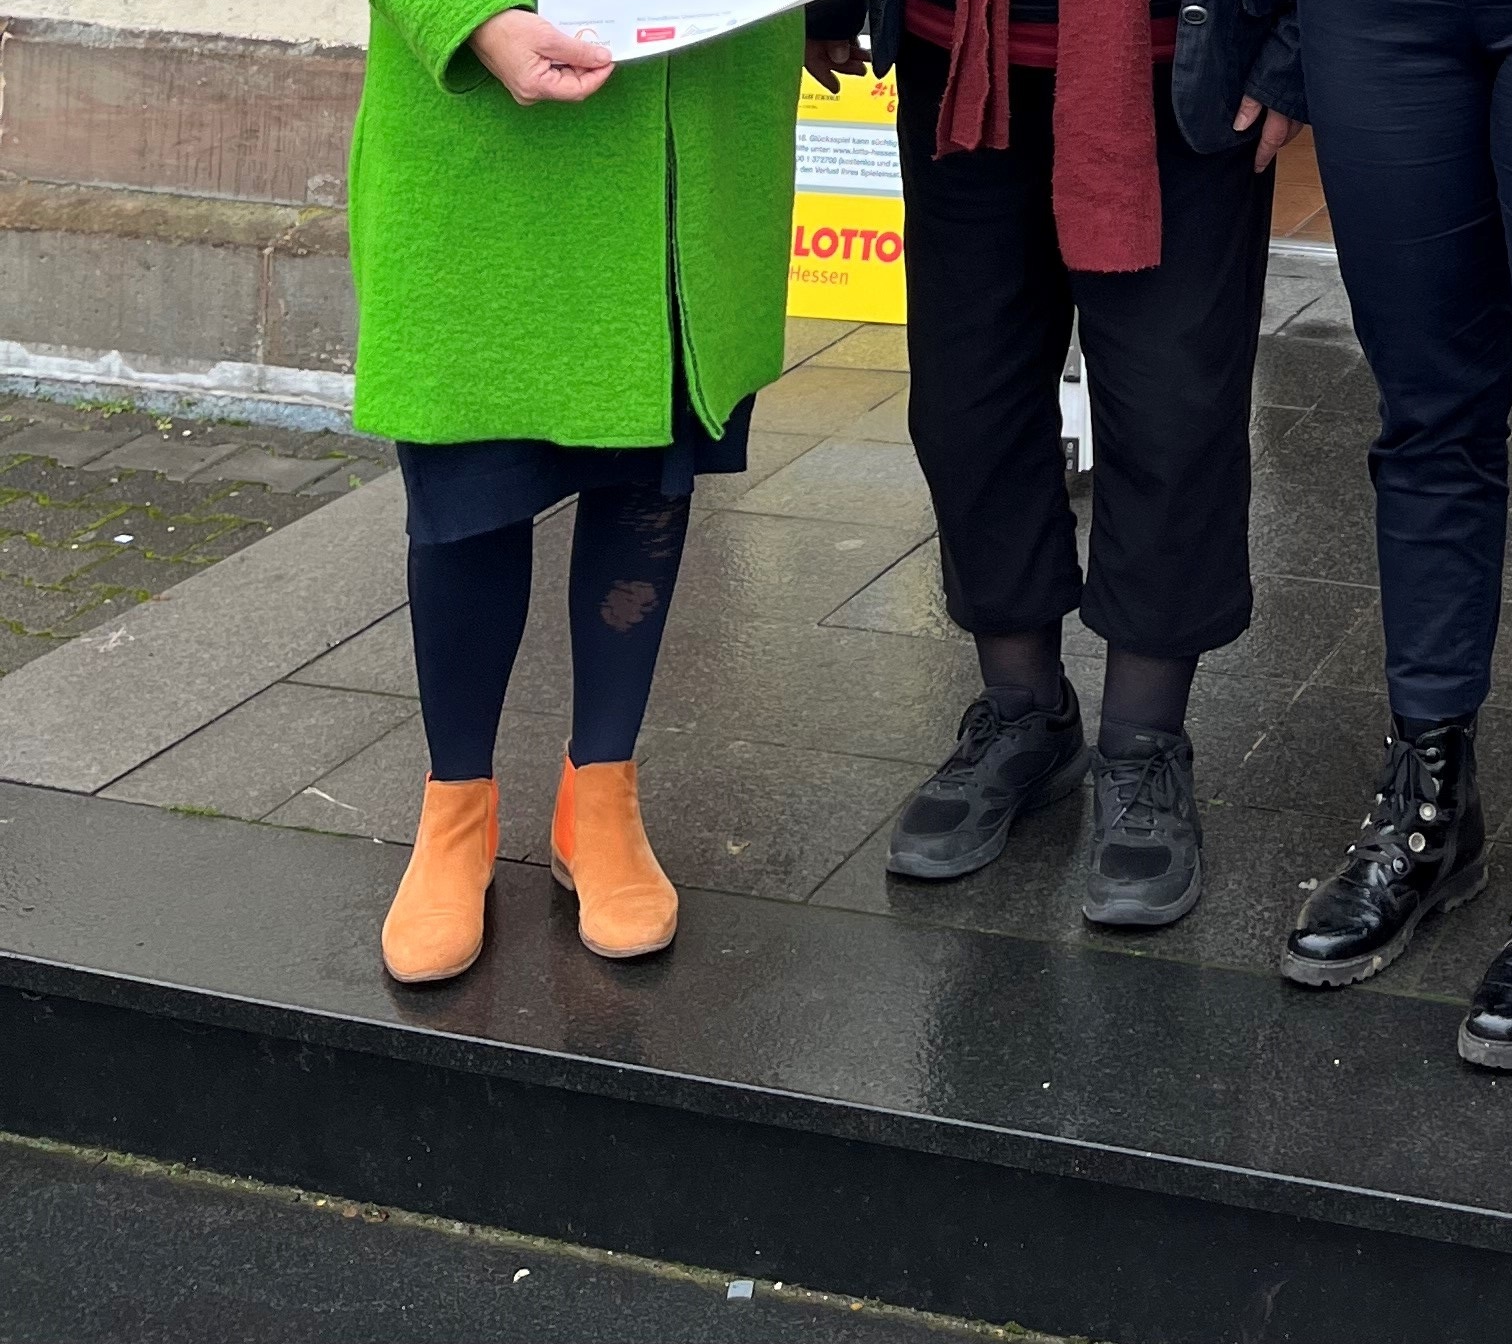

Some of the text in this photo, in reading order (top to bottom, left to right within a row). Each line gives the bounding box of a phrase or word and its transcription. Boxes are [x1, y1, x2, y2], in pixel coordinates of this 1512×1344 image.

[809, 134, 850, 144] Glücksspiel
[852, 137, 869, 145] kann
[793, 225, 903, 263] LOTTO
[789, 265, 849, 285] Hessen
